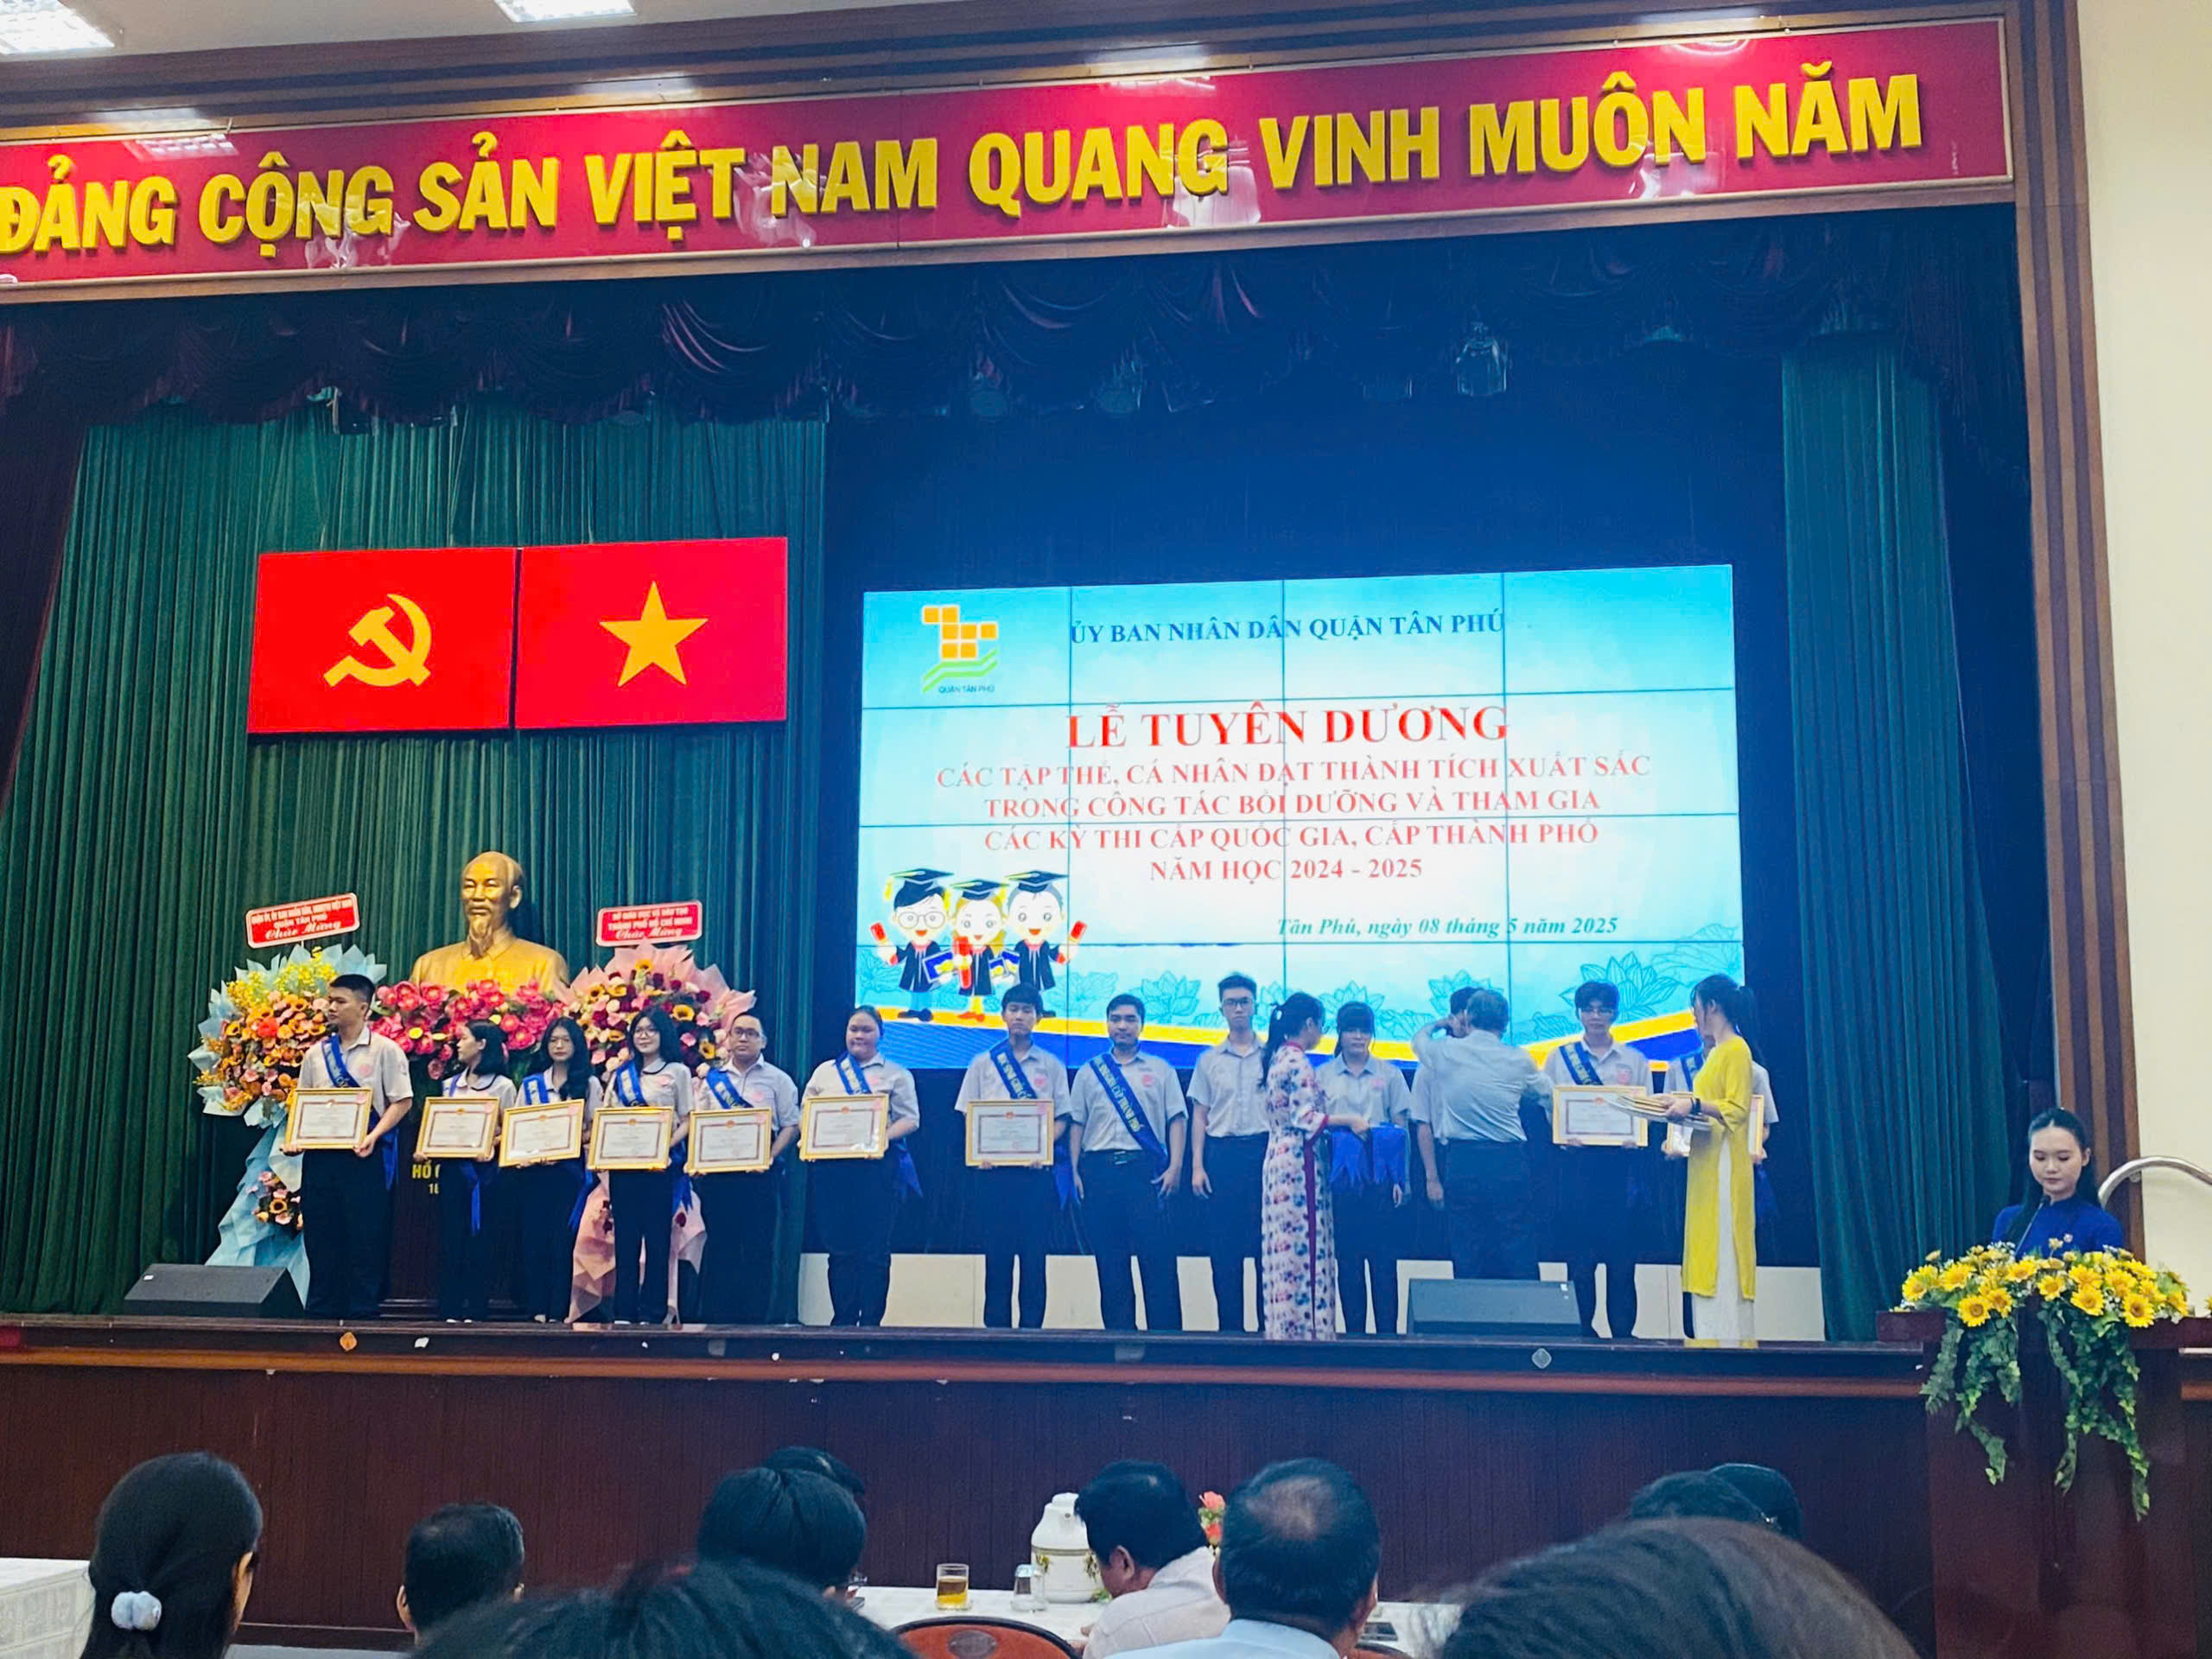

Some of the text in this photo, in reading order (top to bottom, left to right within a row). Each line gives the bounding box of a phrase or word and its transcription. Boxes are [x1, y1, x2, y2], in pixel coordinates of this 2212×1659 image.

[0, 62, 1919, 256] ĐẢNG CỘNG SẢN VIỆT NAM QUANG VINH MUÔN NĂM
[1071, 608, 1504, 644] ỦY BAN NHÂN DÂN QUẬN TÂN PHÚ
[1067, 700, 1510, 748] LỄ TUYÊN DƯƠNG
[937, 763, 993, 787] CÁC
[1000, 763, 1051, 791] TẬP
[1127, 760, 1163, 785] CÁ
[1172, 757, 1249, 783] NHÂN
[1321, 754, 1419, 781] THÀNH
[1428, 753, 1497, 779] TÍCH
[1508, 751, 1586, 778] XUẤT
[984, 797, 1079, 818] TRONG
[1088, 791, 1166, 817] CÔNG
[1174, 790, 1230, 816] TÁC
[1295, 788, 1397, 813] DƯỠNG
[1406, 786, 1444, 811] VÀ
[1452, 790, 1538, 810] THAM
[1548, 789, 1600, 810] GIA
[985, 824, 1040, 851] CÁC
[1094, 830, 1141, 849] THI
[1211, 822, 1291, 852] QUỐC
[1300, 825, 1357, 848] GIA,
[1427, 819, 1528, 845] THÀNH
[1150, 856, 1211, 880] NĂM
[1222, 860, 1281, 885] HỌC
[1290, 860, 1343, 879] 2024
[1368, 858, 1422, 879] 2025
[1278, 917, 1618, 938] Tân Phú, ngày 08 tháng 5 năm 2025
